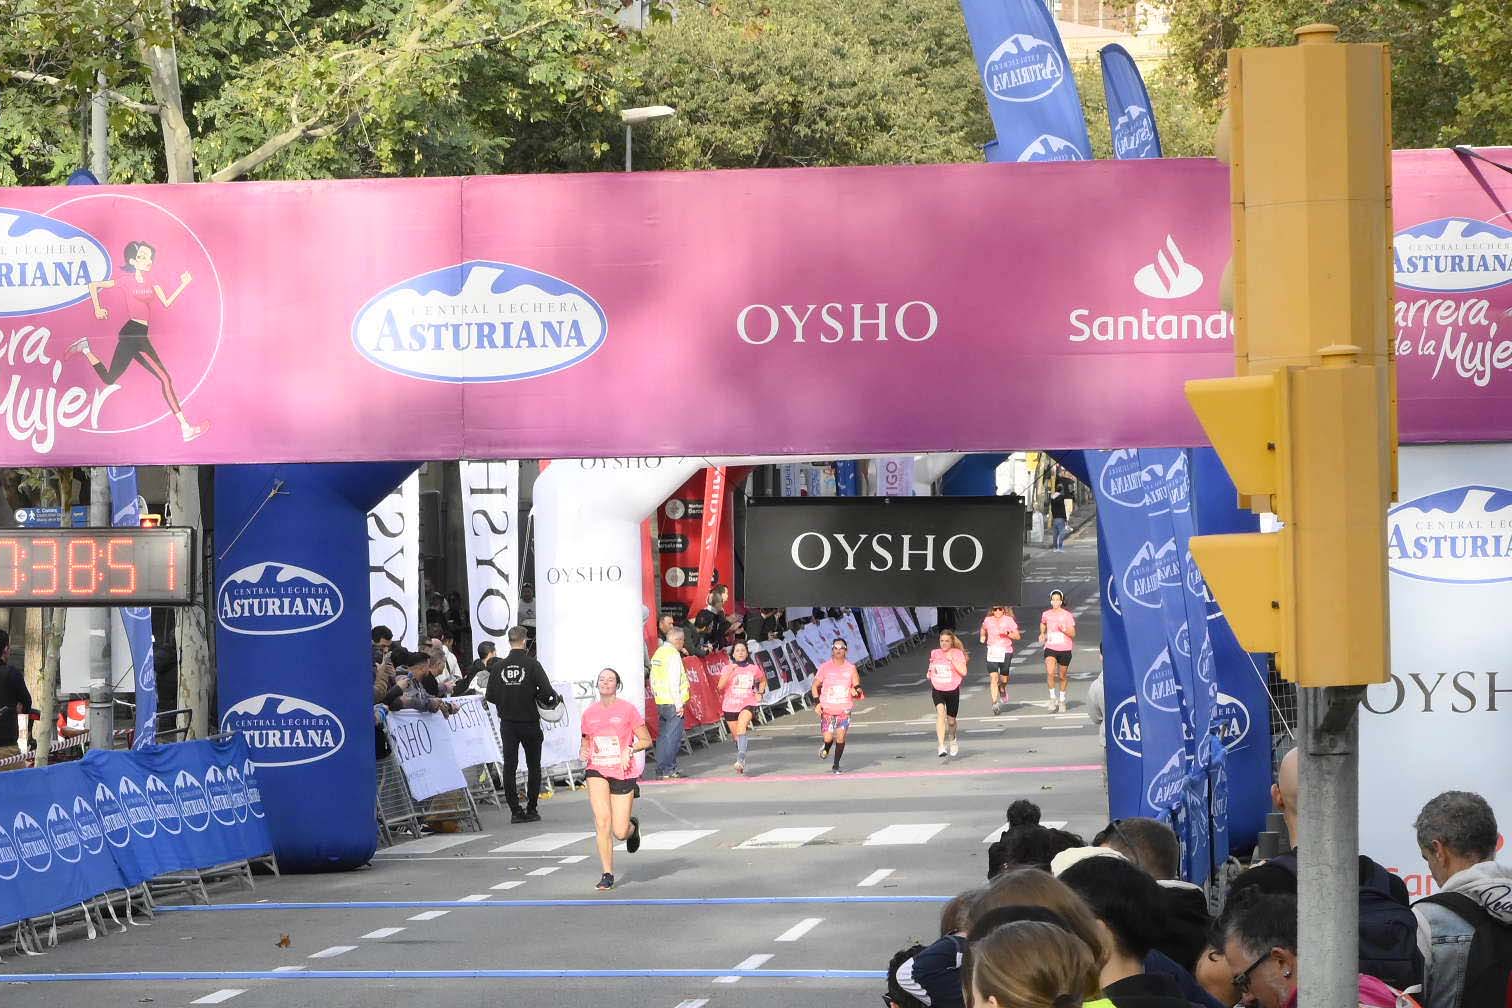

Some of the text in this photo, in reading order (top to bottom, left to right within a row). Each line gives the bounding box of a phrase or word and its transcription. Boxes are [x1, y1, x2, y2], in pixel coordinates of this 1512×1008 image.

[14, 244, 87, 256] LECHERA
[1408, 242, 1459, 251] CENTRAL
[410, 301, 579, 316] CENTRAL LECHERA
[1395, 299, 1490, 327] arrera
[371, 308, 587, 352] ASTURIANA
[736, 301, 939, 345] OYSHO
[1069, 308, 1236, 342] Santand
[1418, 328, 1436, 356] la
[1431, 322, 1512, 387] Muje
[1415, 519, 1483, 530] CENTRAL
[791, 532, 984, 573] OYSHO
[547, 565, 622, 585] OYSHO
[234, 586, 329, 595] CENTRAL LECHERA
[221, 592, 334, 619] ASTURIANA
[507, 669, 520, 678] BP
[1364, 671, 1512, 715] OYSH
[236, 718, 330, 727] CENTRAL LECHERA
